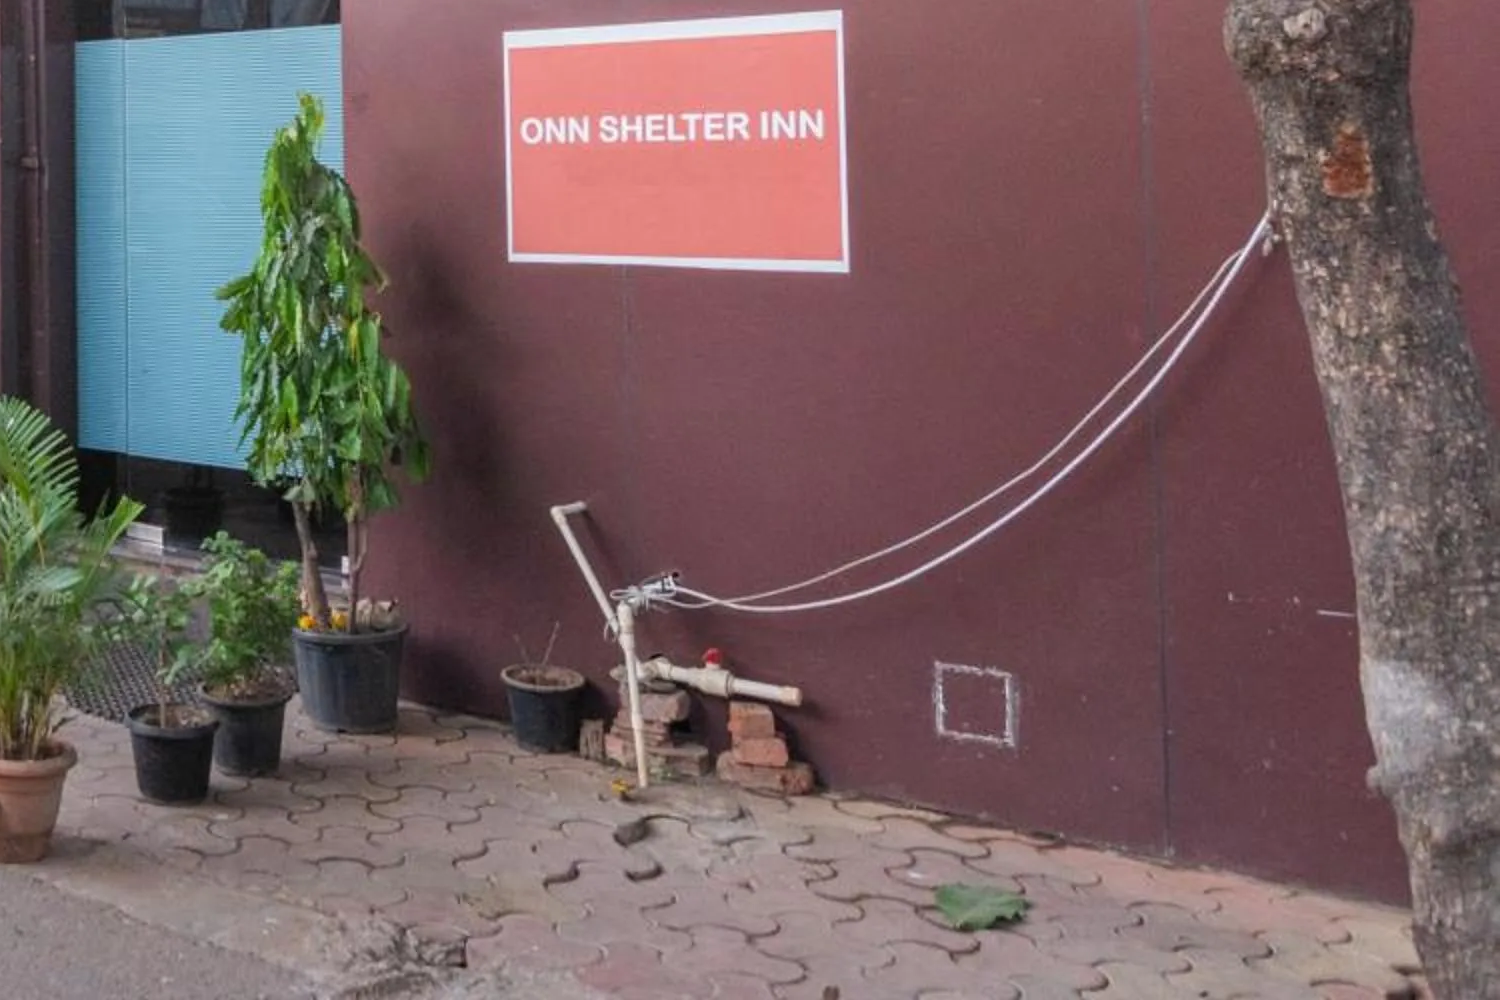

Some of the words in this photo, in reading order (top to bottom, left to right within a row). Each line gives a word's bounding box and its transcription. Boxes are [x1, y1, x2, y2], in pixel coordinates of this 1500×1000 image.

[520, 115, 590, 145] ONN
[599, 112, 750, 143] SHELTER
[760, 109, 825, 140] INN
